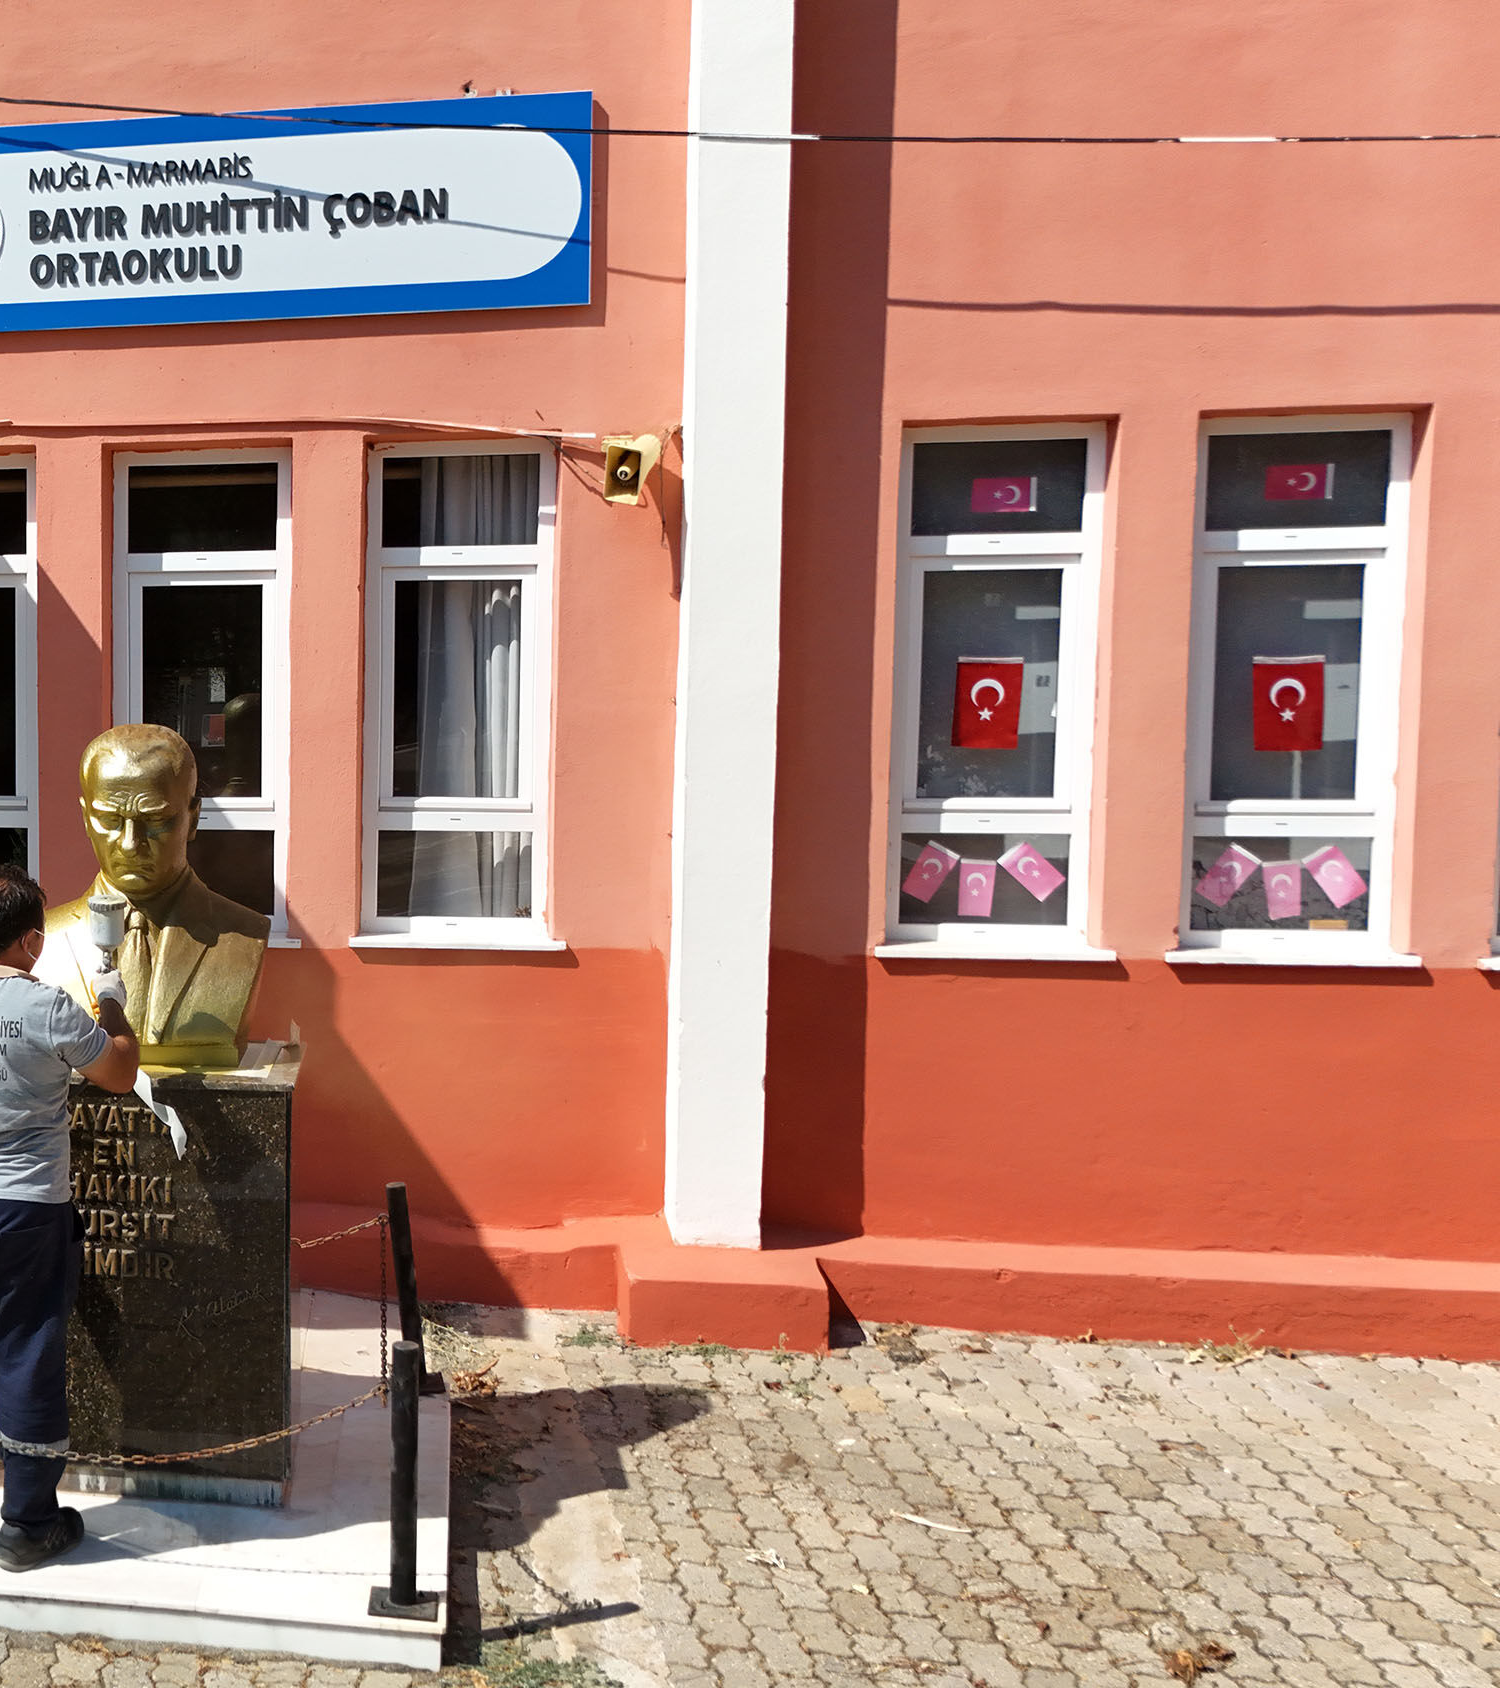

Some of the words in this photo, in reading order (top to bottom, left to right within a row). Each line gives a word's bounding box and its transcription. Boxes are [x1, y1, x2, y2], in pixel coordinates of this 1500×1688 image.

[29, 206, 128, 243] BAYIR
[141, 189, 309, 239] MUHİTTİN
[323, 188, 449, 239] ÇOBAN
[29, 244, 242, 288] ORTAOKULU
[93, 1138, 137, 1166] EN
